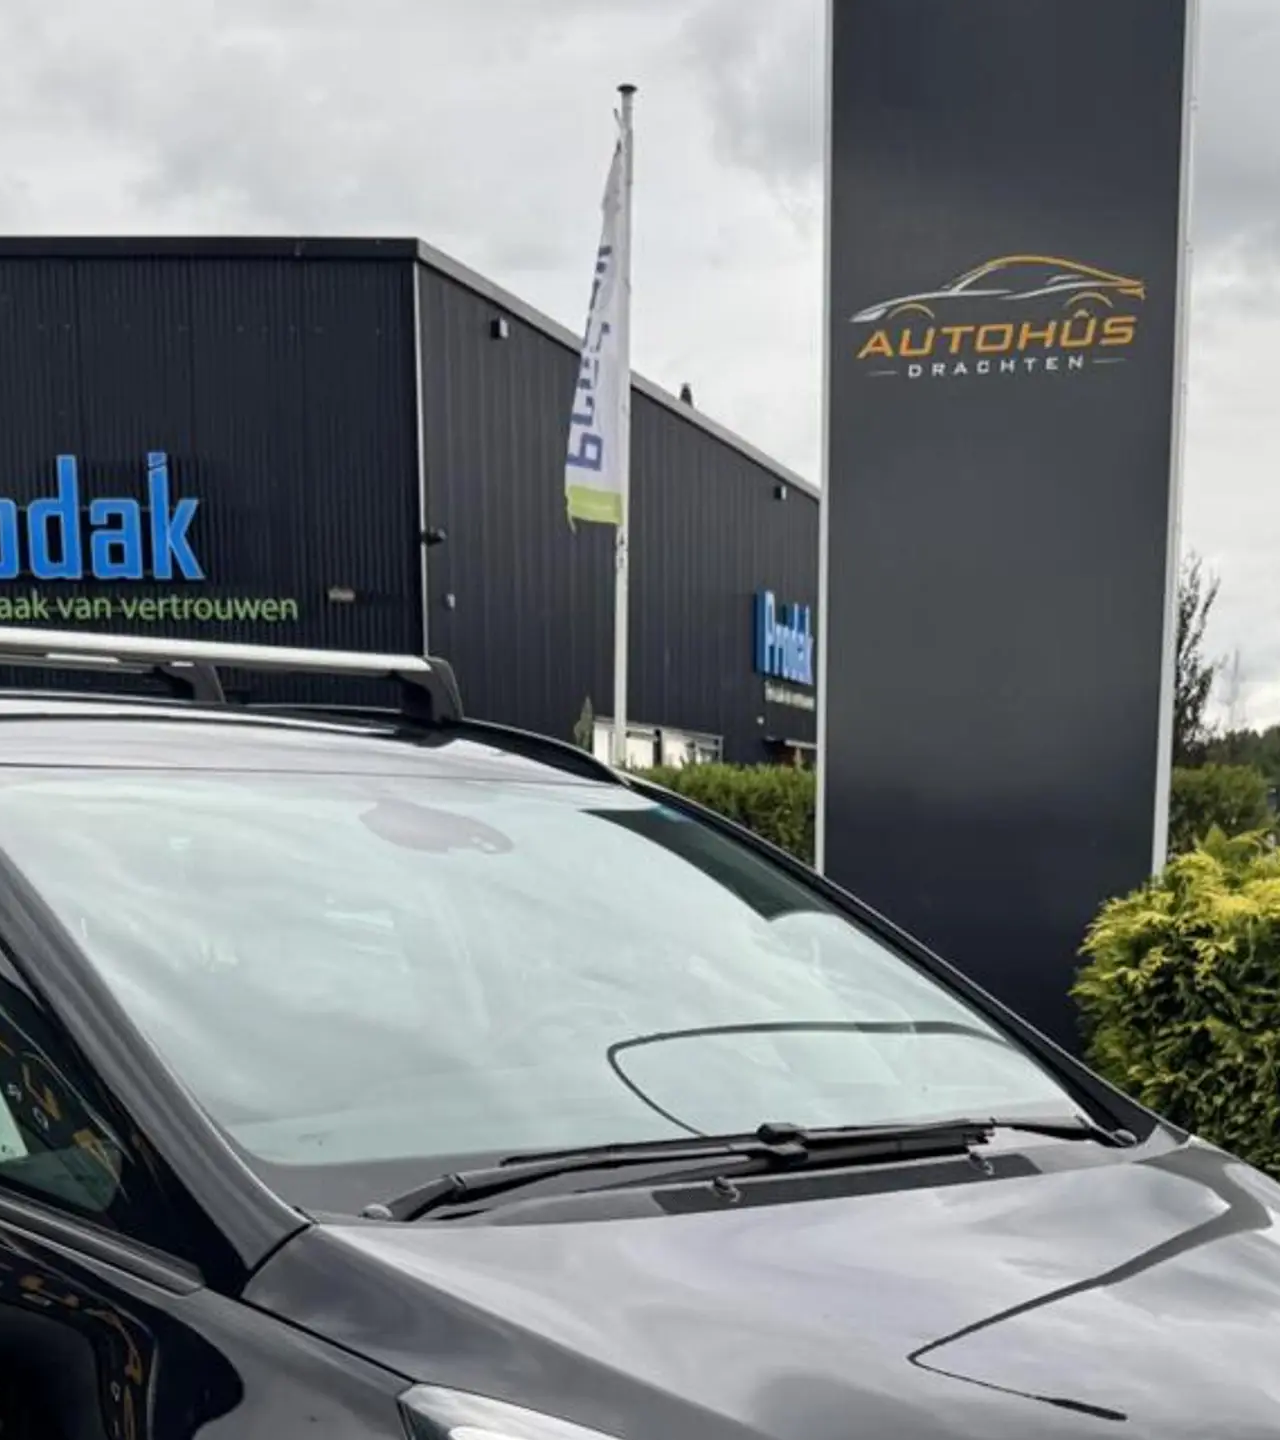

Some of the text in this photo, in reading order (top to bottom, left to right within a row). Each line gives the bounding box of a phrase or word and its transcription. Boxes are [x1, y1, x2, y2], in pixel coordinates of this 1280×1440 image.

[856, 308, 1138, 359] AUTOHÛS
[907, 355, 1085, 379] DRACHTEN
[55, 596, 110, 621] van
[118, 593, 299, 622] vertrouwen
